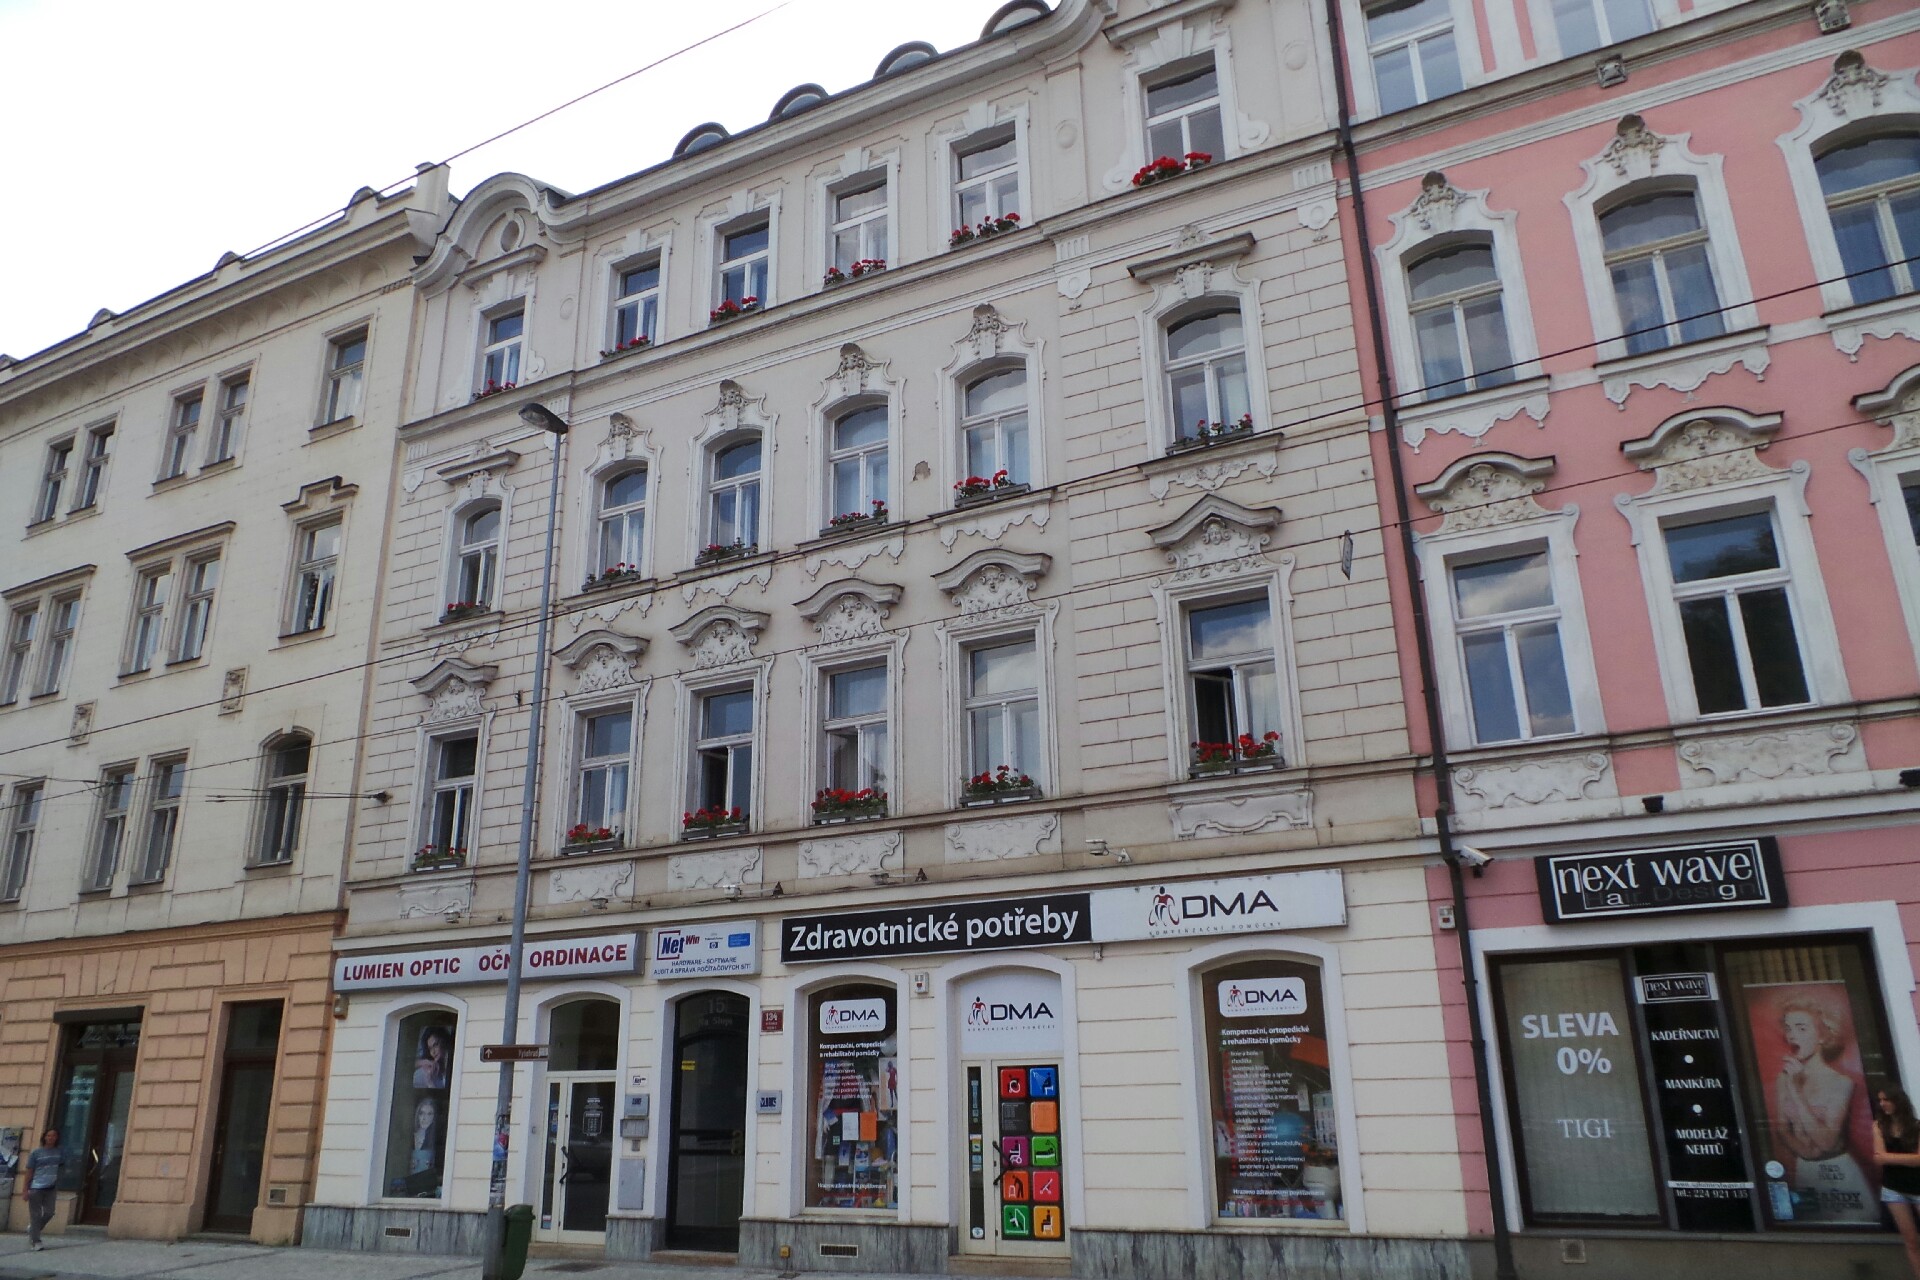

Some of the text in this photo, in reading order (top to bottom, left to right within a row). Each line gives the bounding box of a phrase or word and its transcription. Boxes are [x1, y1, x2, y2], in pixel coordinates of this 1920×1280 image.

[1558, 852, 1753, 894] next wave
[1181, 890, 1279, 919] DMA
[790, 904, 1079, 951] Zdravotnické potřeby
[343, 944, 628, 981] LUMIEN OPTIC OČN ORDINACE
[672, 959, 702, 967] HARDWARE
[706, 957, 737, 965] SOFTWARE
[675, 966, 696, 974] SPRÁVA
[1646, 979, 1705, 992] next wave
[1245, 989, 1298, 1003] DMA
[766, 1012, 778, 1022] 134
[840, 1009, 879, 1021] DMA
[990, 1002, 1054, 1020] DMA
[1221, 1025, 1310, 1036] Kompenzační, ortopedické
[1522, 1012, 1620, 1039] SLEVA
[1228, 1036, 1269, 1045] rehabilitační
[1269, 1036, 1302, 1045] pomůcky
[1651, 1027, 1720, 1041] KADEŘNICTVÍ
[1557, 1047, 1612, 1075] 0%
[1665, 1076, 1723, 1089] MANIKÚRA
[1557, 1119, 1612, 1139] TIGI
[1675, 1127, 1729, 1140] MODELÁŽ
[1685, 1142, 1724, 1155] NEHTŮ
[1694, 1189, 1710, 1198] 224
[1712, 1190, 1729, 1199] 921
